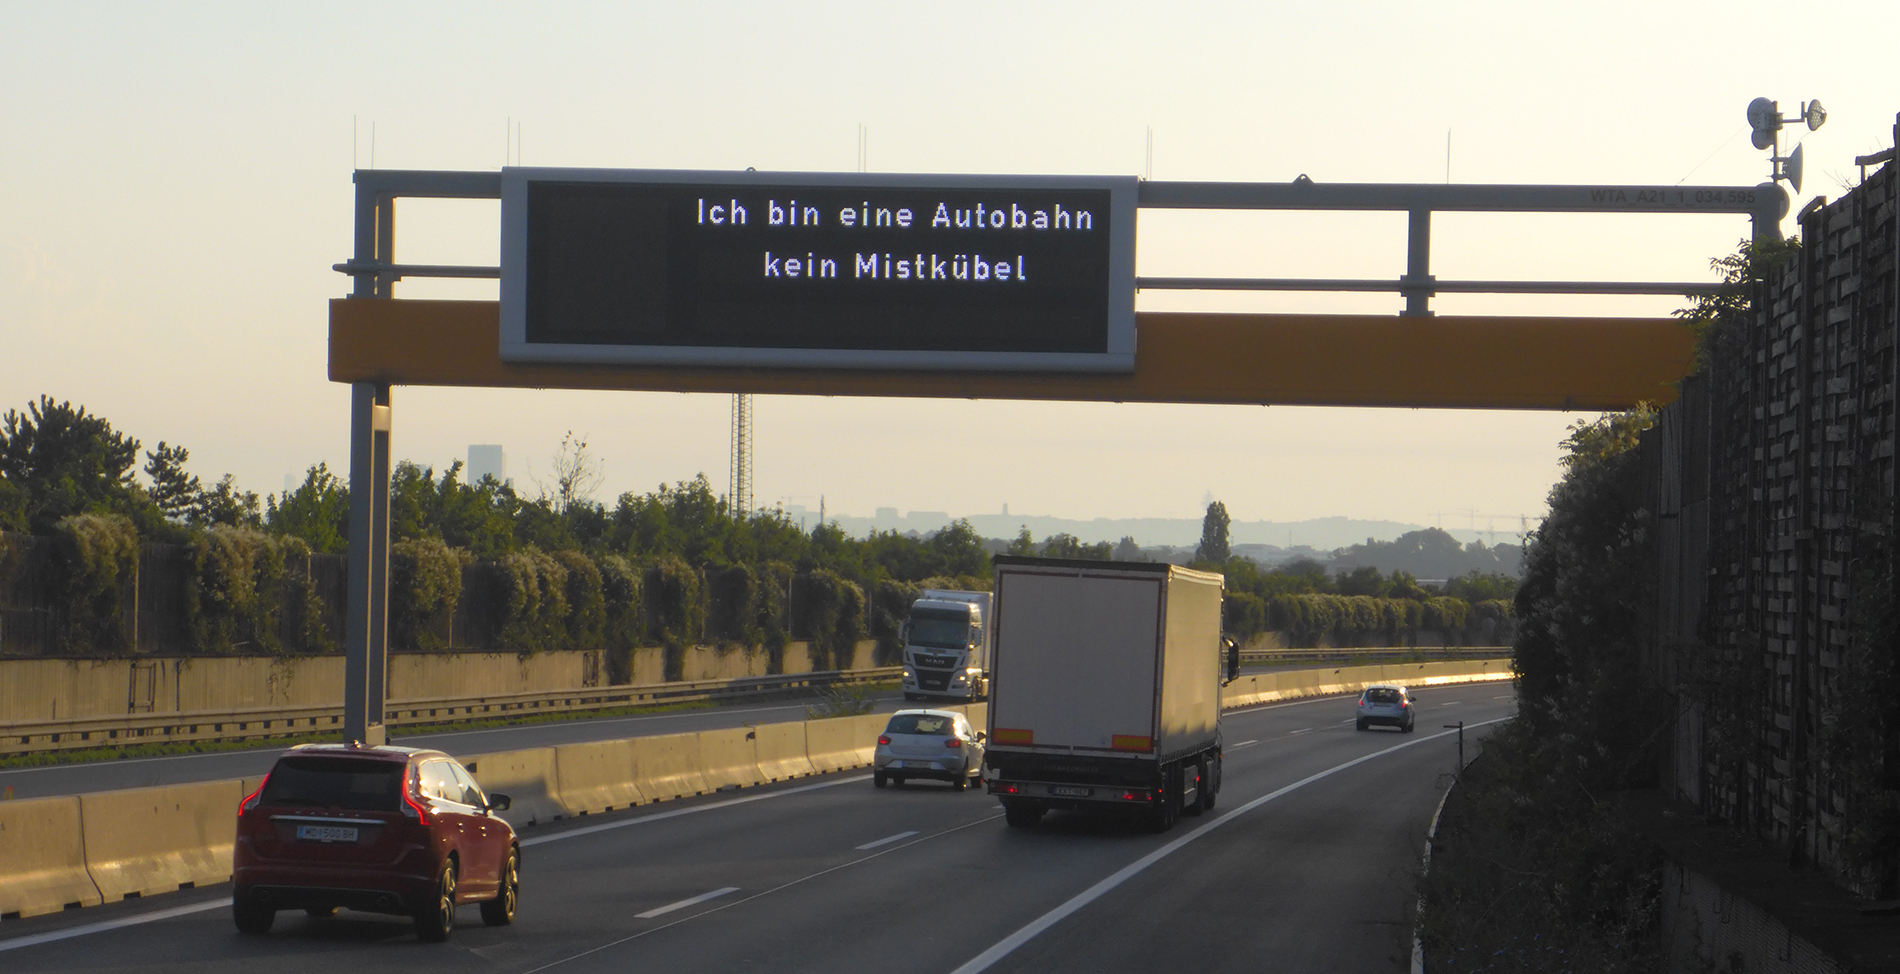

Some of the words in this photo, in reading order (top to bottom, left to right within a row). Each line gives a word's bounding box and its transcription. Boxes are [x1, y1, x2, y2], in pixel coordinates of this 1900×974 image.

[697, 198, 746, 225] Ich
[768, 199, 819, 226] bin
[839, 201, 913, 228] eine
[931, 202, 1092, 230] Autobahn
[764, 251, 836, 278] kein
[854, 252, 1026, 281] Mistkübel
